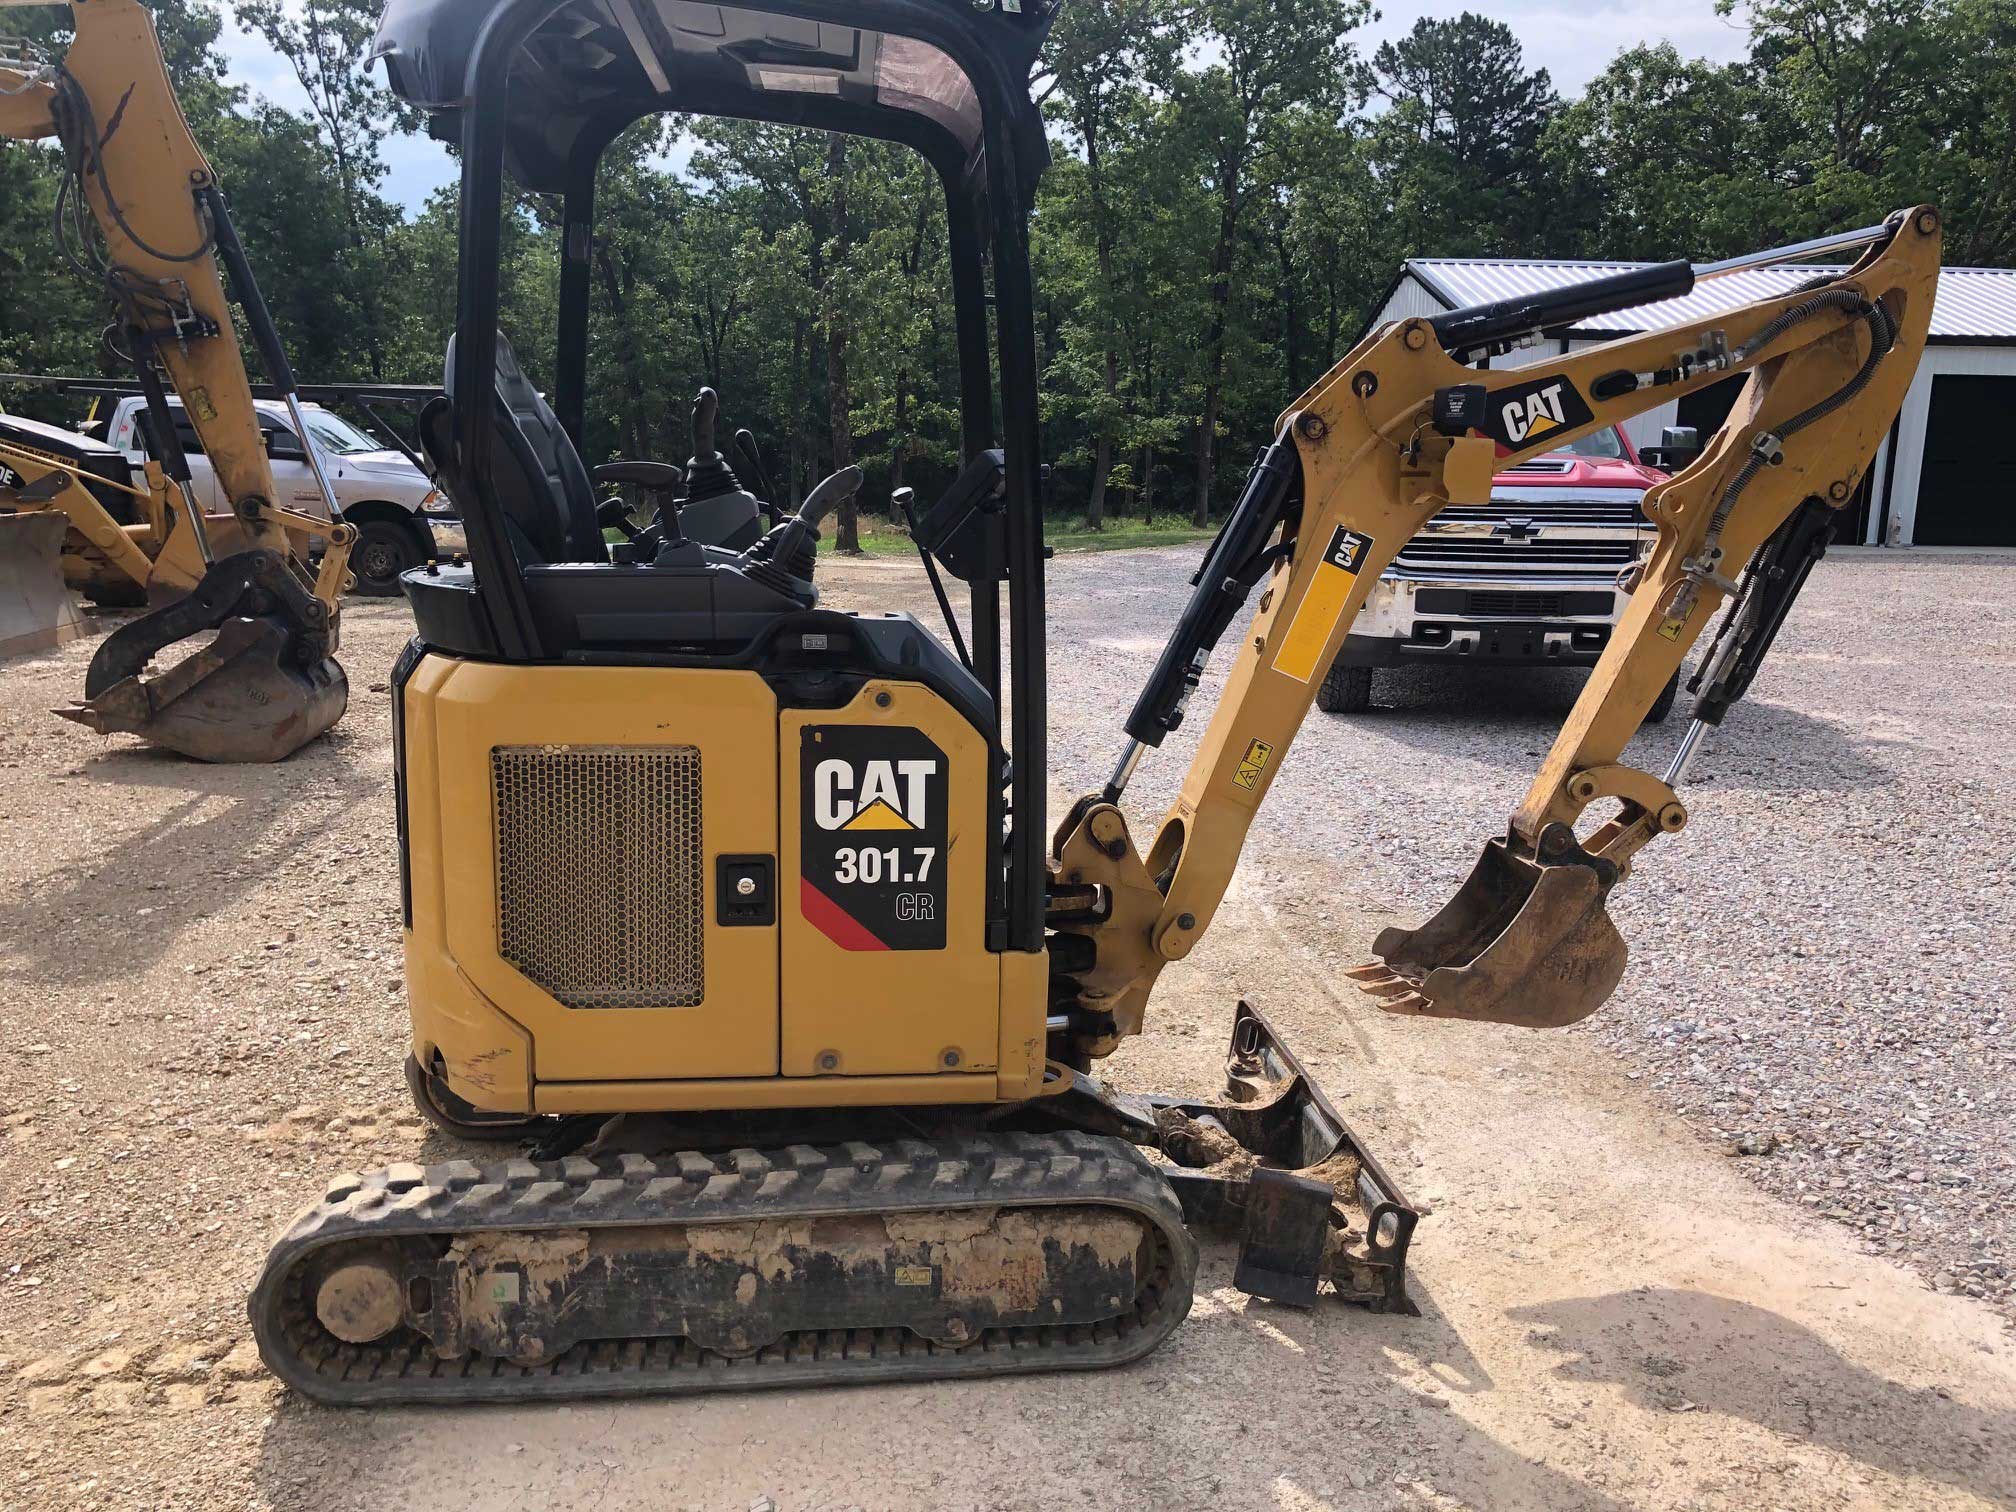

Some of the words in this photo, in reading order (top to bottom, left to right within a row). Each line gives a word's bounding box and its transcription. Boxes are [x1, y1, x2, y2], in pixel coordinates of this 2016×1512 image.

[1501, 383, 1565, 442] CAT
[1334, 532, 1362, 567] CAT
[814, 758, 936, 830] CAT
[834, 847, 935, 884] 301.7
[895, 892, 934, 921] CR
